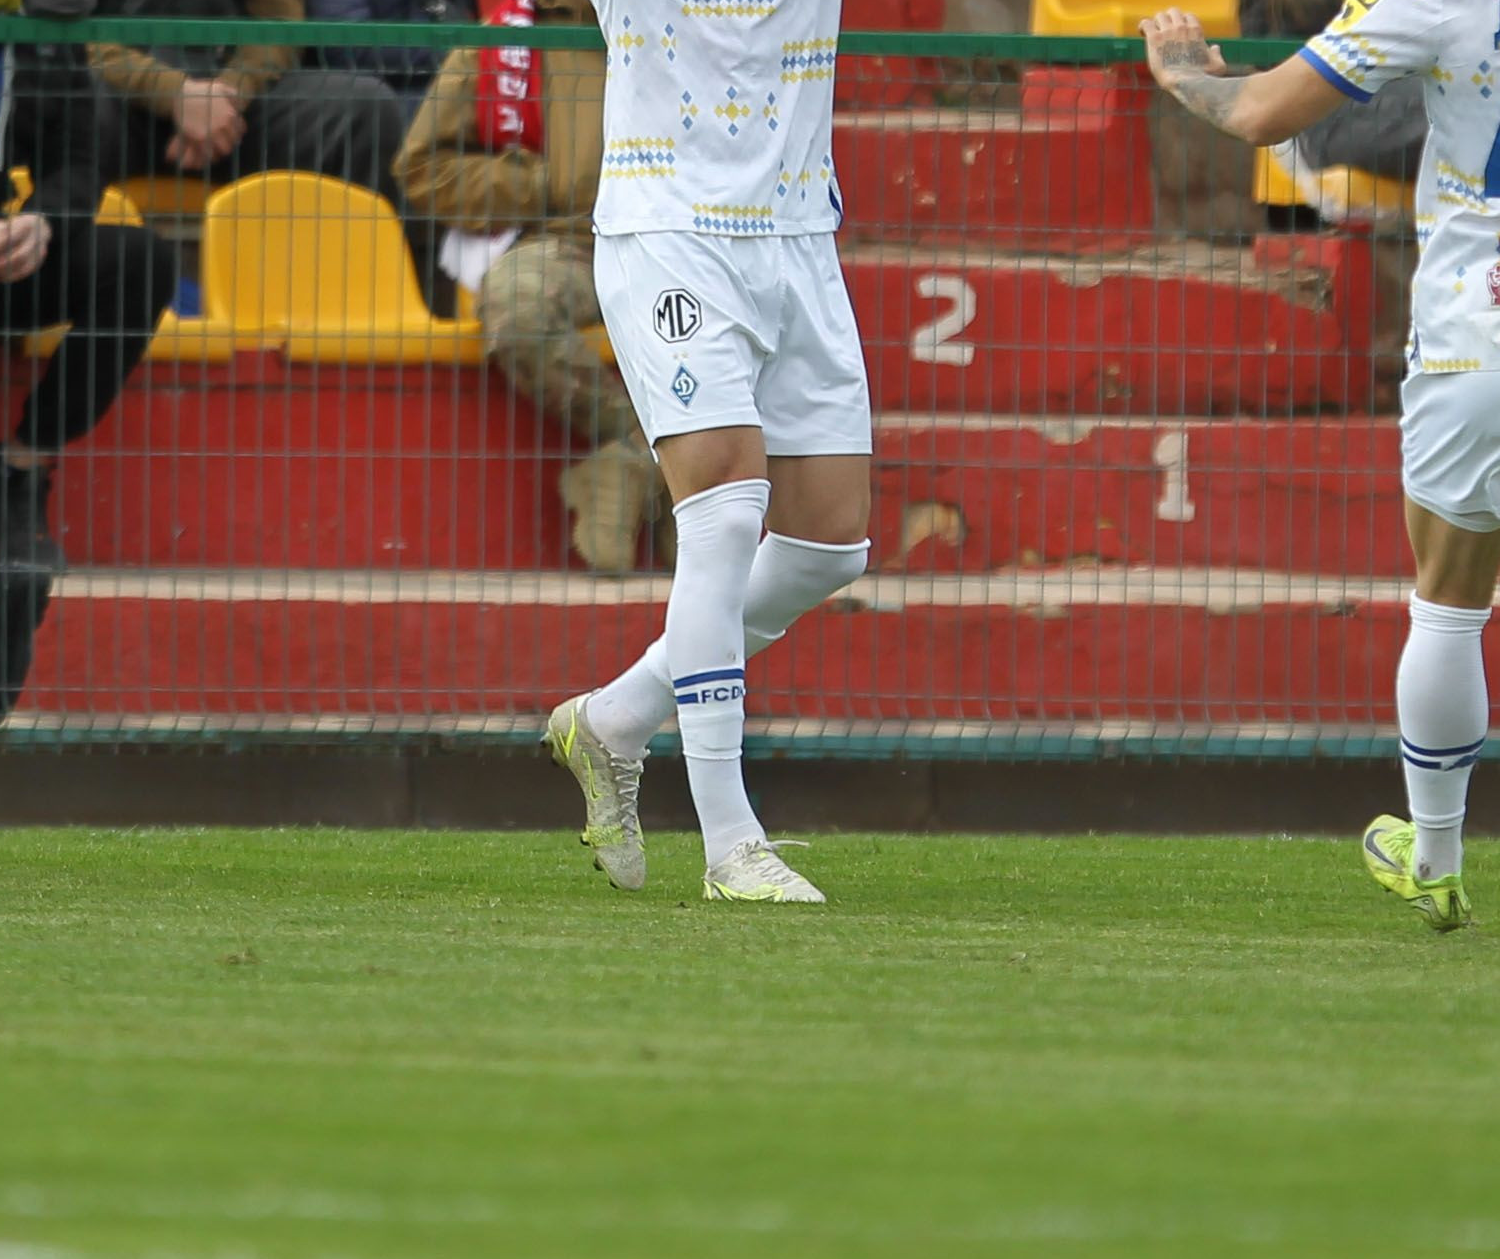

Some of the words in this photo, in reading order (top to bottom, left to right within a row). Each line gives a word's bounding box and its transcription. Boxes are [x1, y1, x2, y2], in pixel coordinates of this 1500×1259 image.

[655, 295, 701, 341] MG
[911, 273, 977, 367] 2
[1154, 431, 1196, 523] 1
[701, 685, 744, 704] FCD
